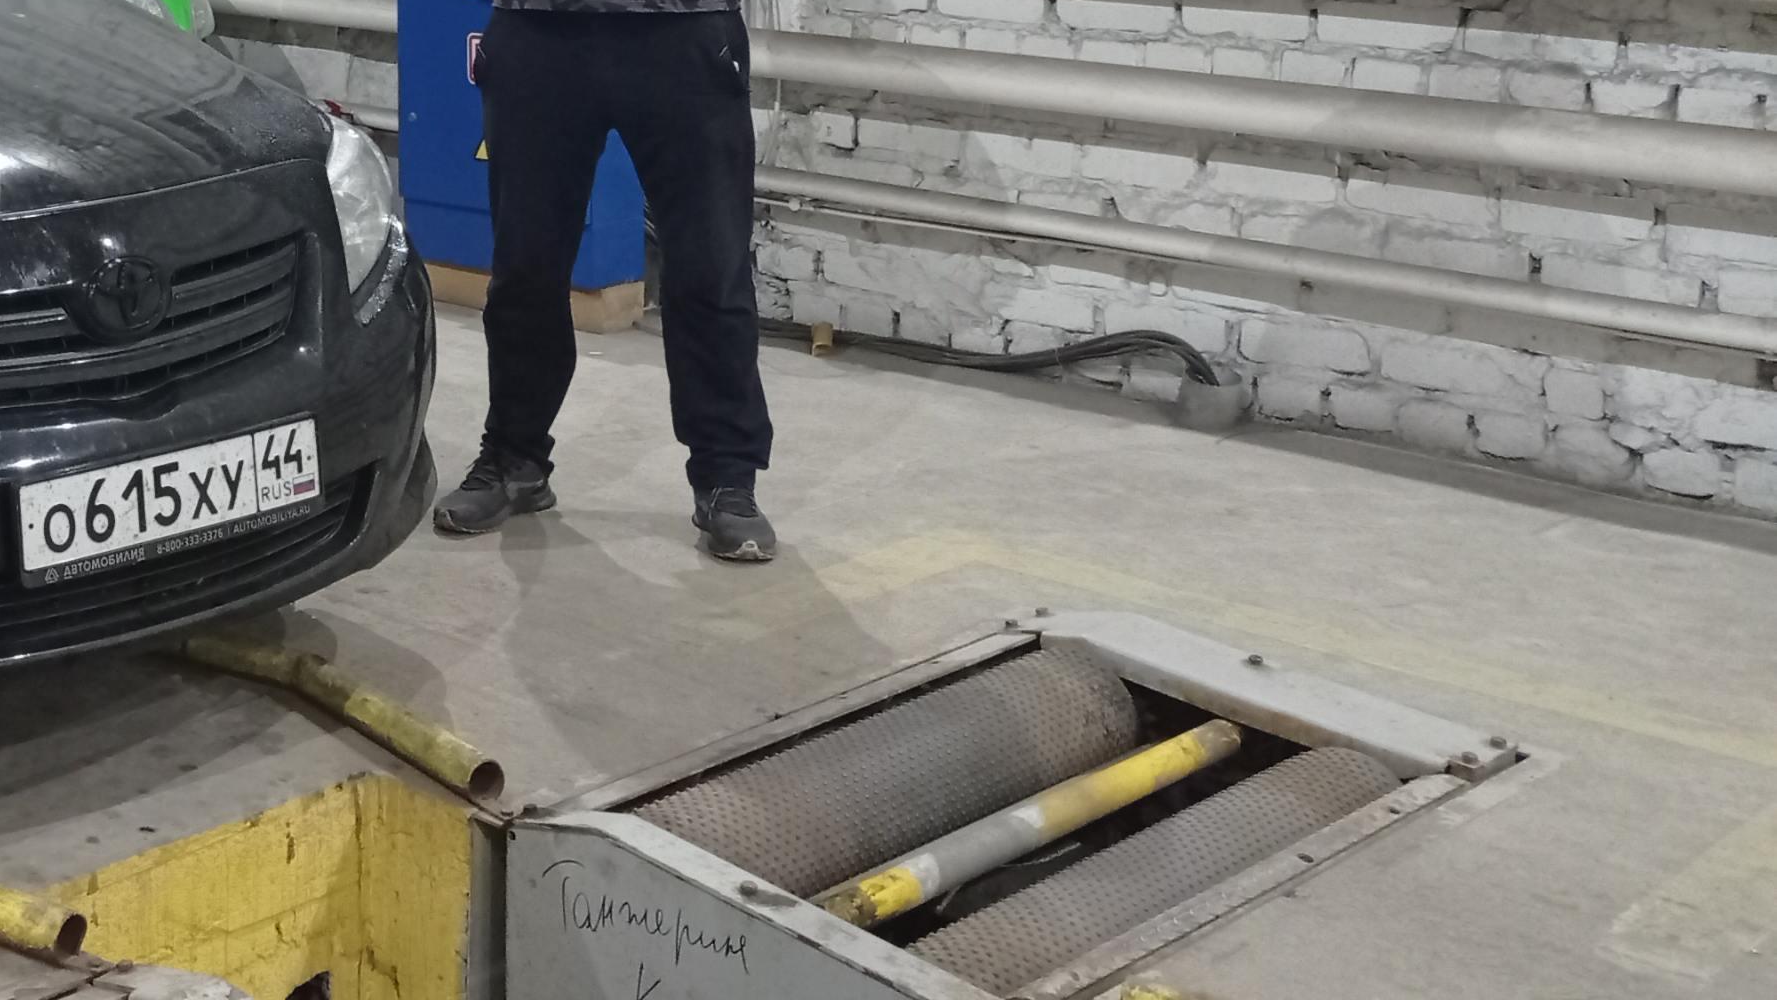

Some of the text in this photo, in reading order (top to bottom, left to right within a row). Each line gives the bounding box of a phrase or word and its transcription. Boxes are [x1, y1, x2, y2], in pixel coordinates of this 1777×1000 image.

[261, 428, 304, 480] 44
[261, 478, 292, 502] RUS
[64, 547, 145, 580] АВТОМОБИЛИЯ
